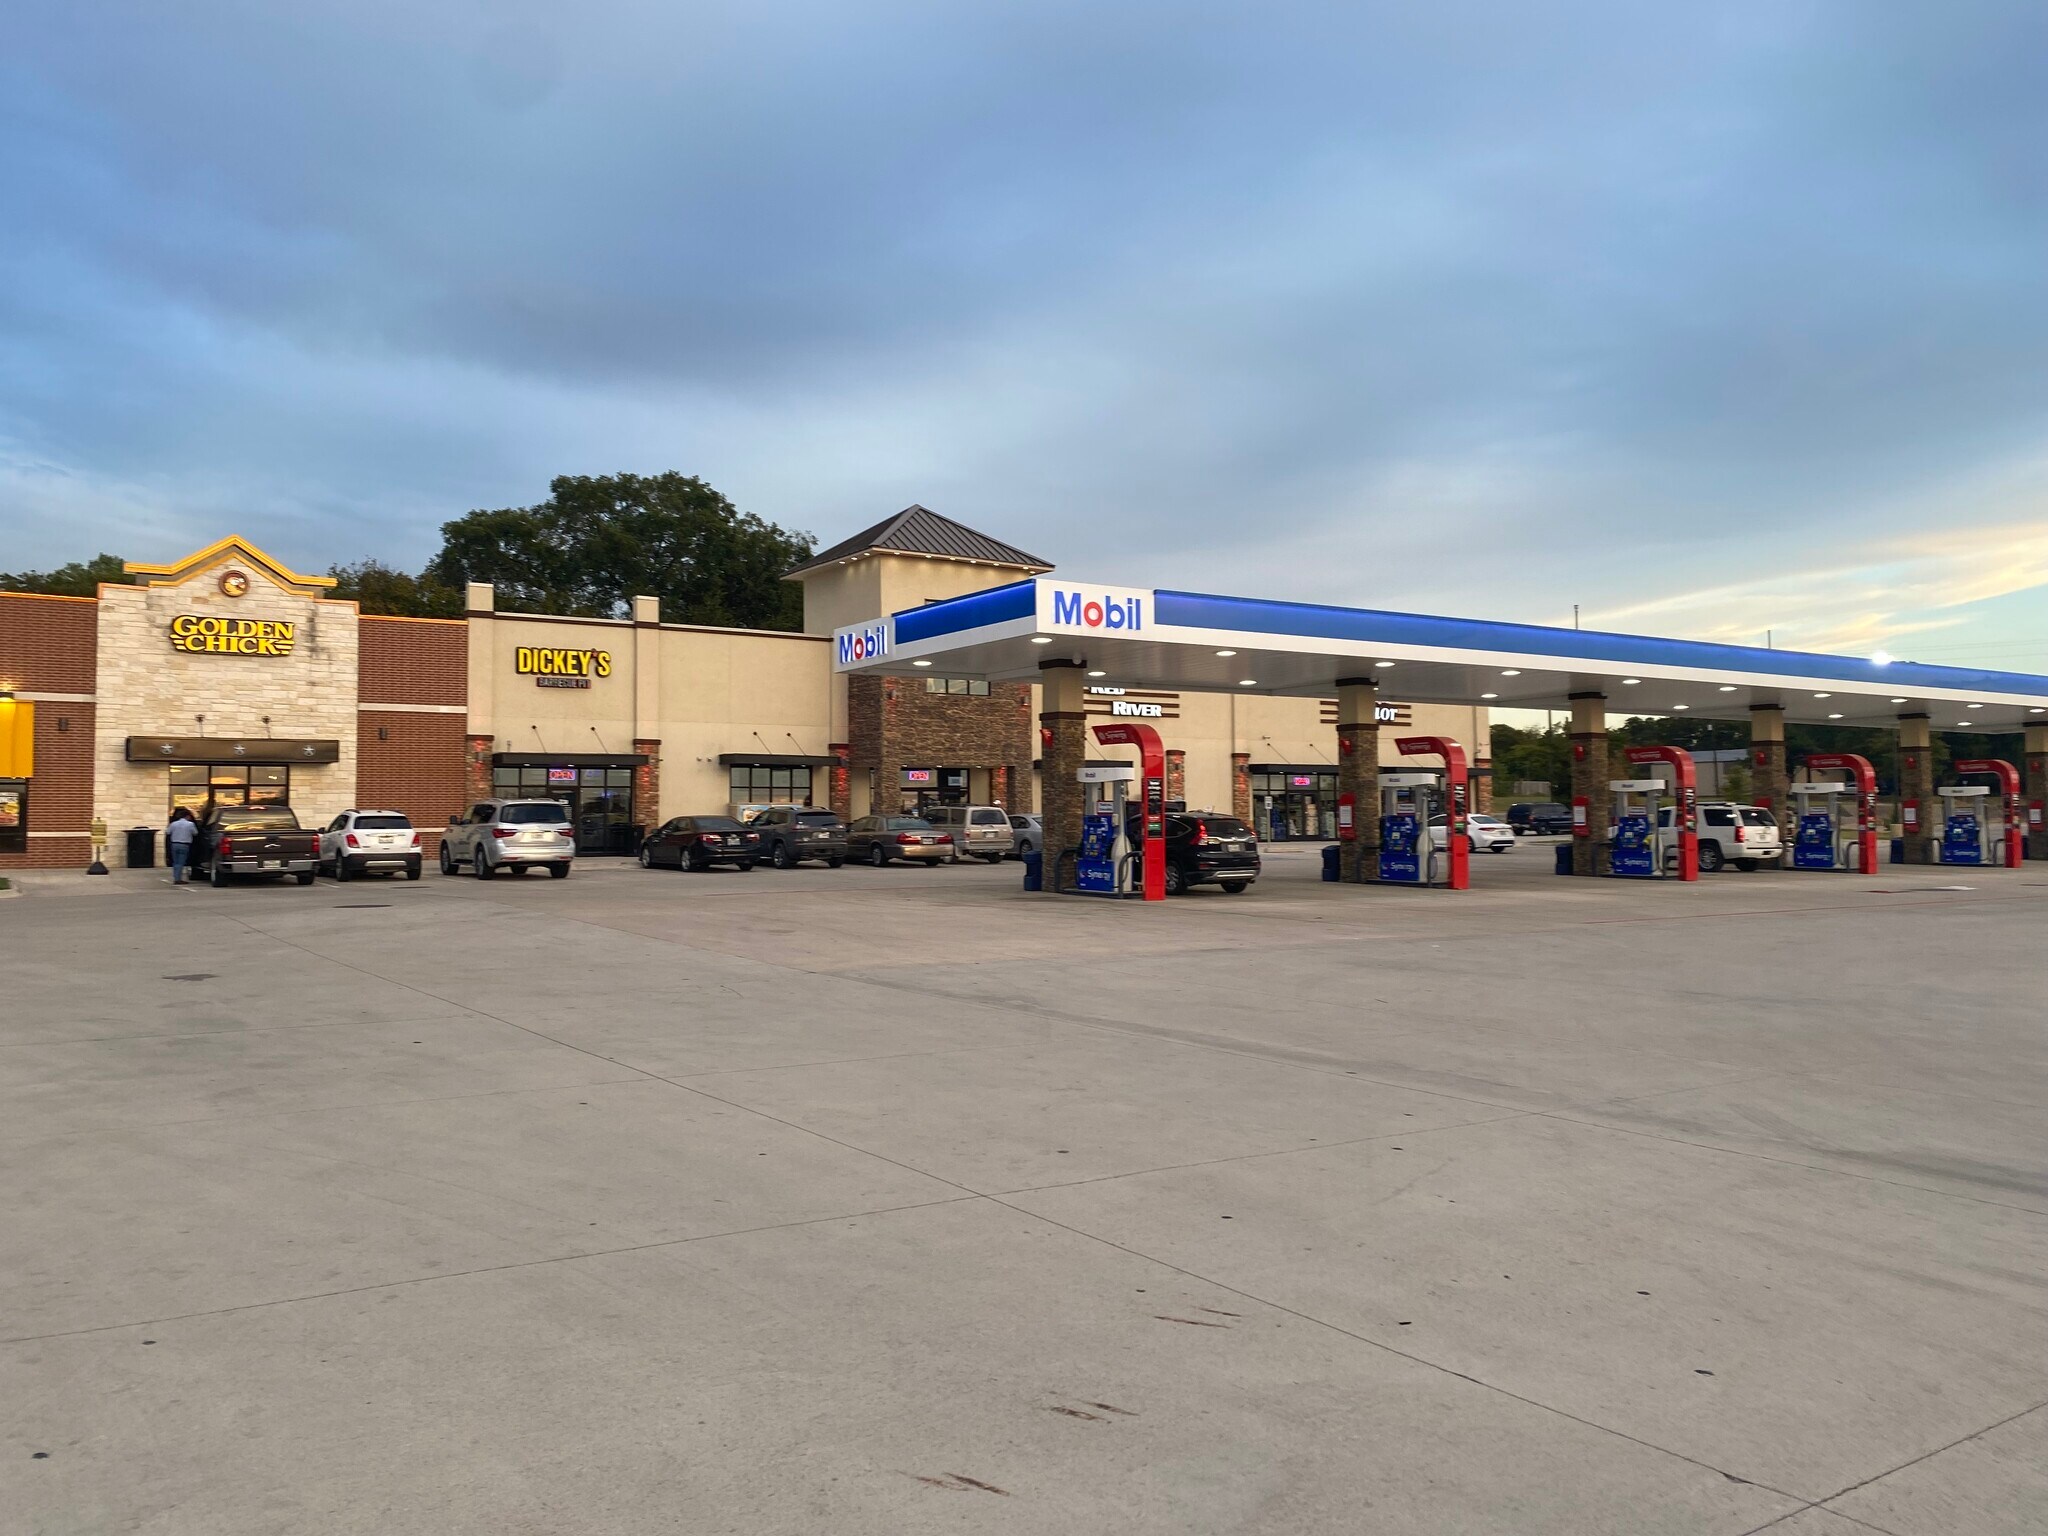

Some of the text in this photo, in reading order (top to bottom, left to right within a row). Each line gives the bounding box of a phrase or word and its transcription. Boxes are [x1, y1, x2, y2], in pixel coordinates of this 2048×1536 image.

[1053, 590, 1142, 631] Mobil
[173, 616, 295, 639] GOLDEN
[184, 635, 281, 655] CHICK
[839, 625, 888, 664] Mobil
[517, 648, 611, 676] DICKEY'S
[1112, 701, 1162, 716] RIVER
[549, 771, 574, 779] OPEN
[1087, 869, 1111, 881] Synergy
